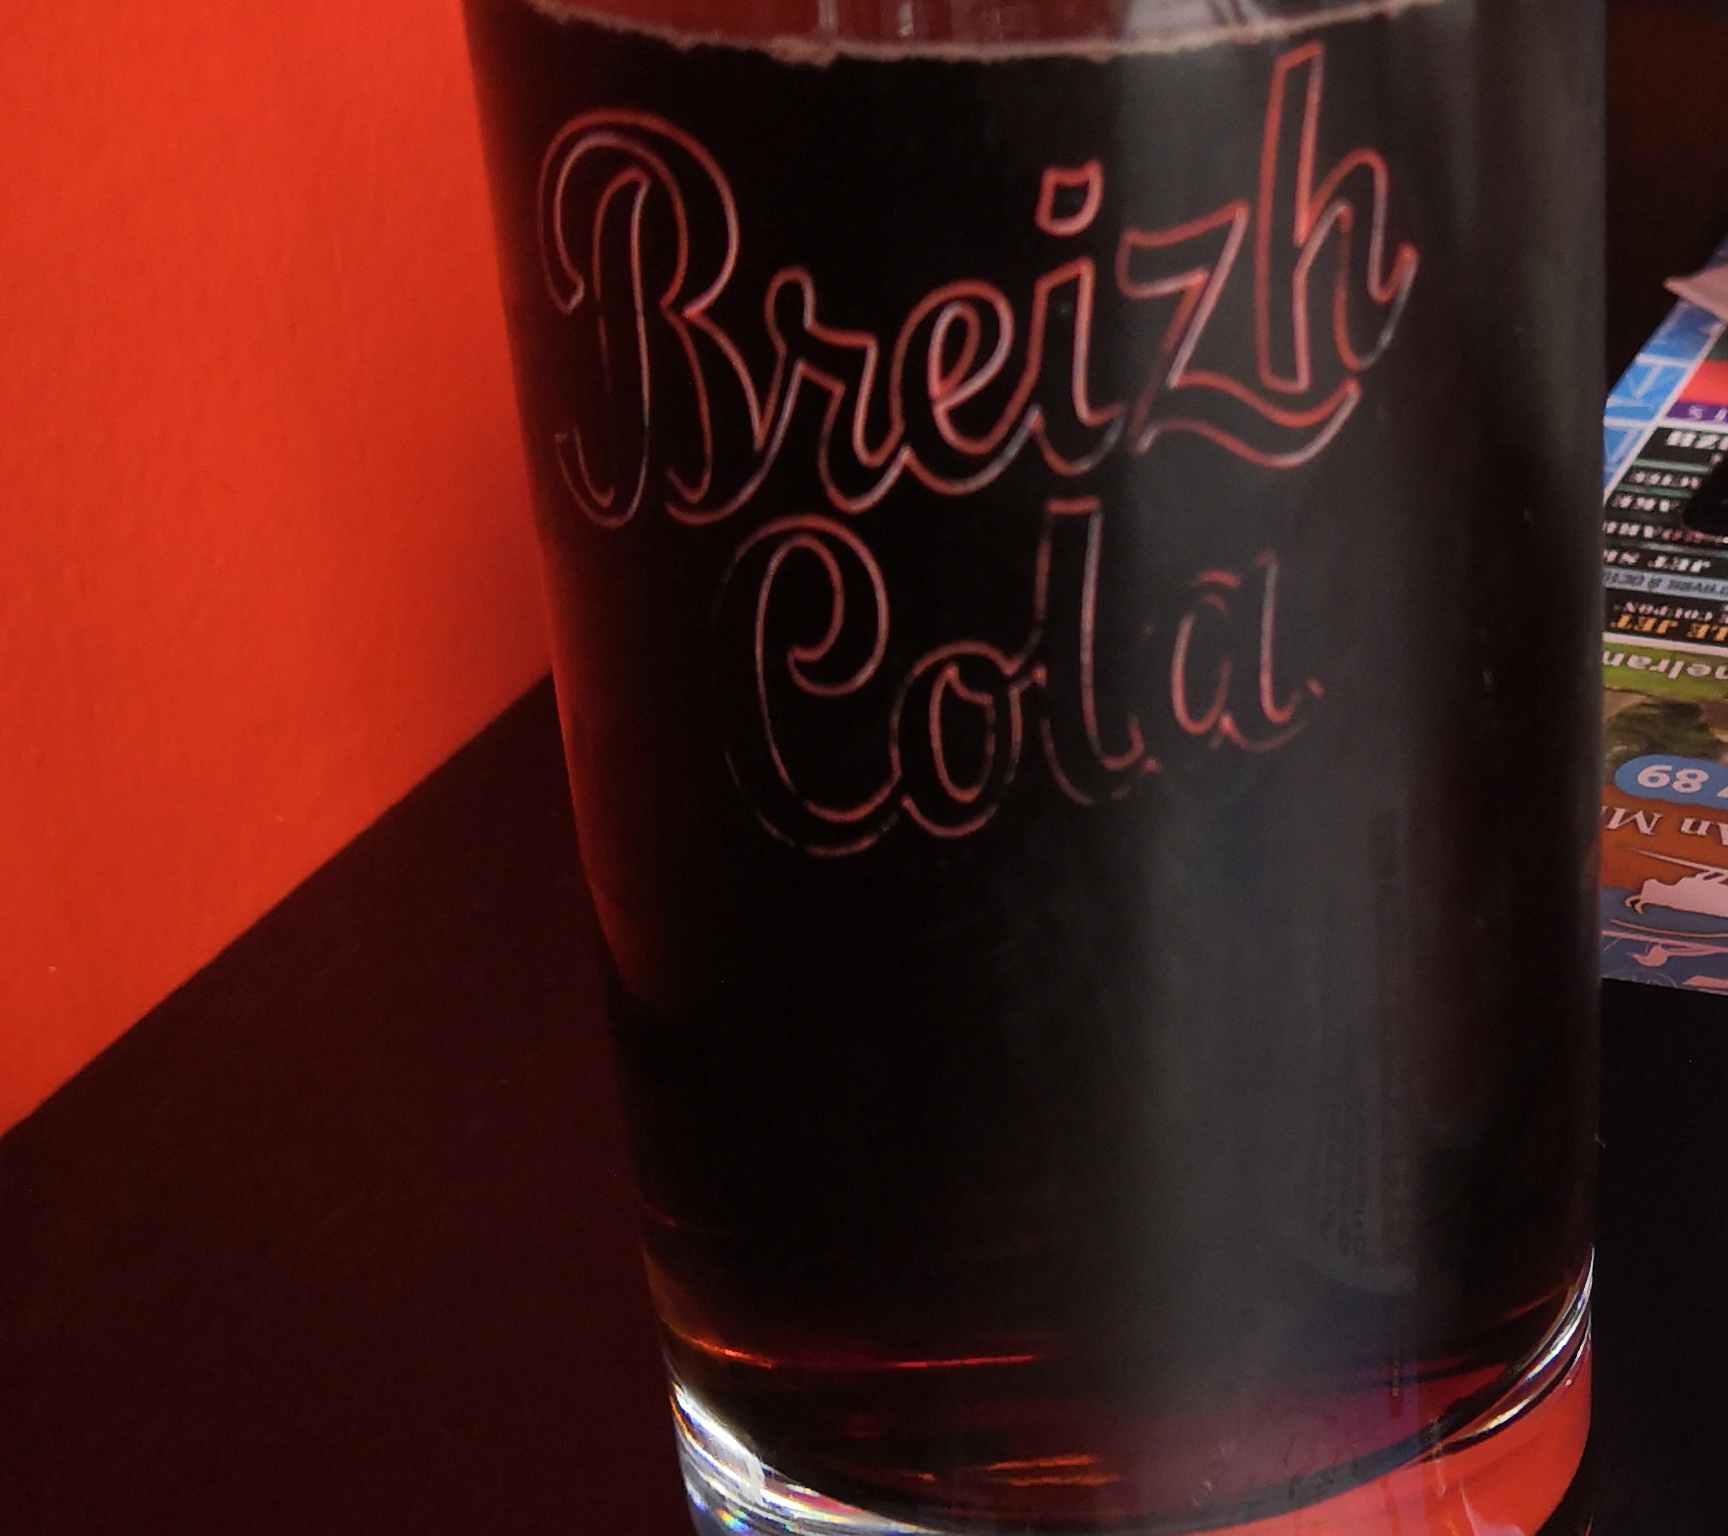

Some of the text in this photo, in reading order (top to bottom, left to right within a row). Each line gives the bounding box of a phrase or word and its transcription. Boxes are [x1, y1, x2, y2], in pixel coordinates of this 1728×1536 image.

[539, 39, 1420, 529] Breizh
[713, 495, 1325, 857] Cola
[1637, 764, 1709, 793] 89
